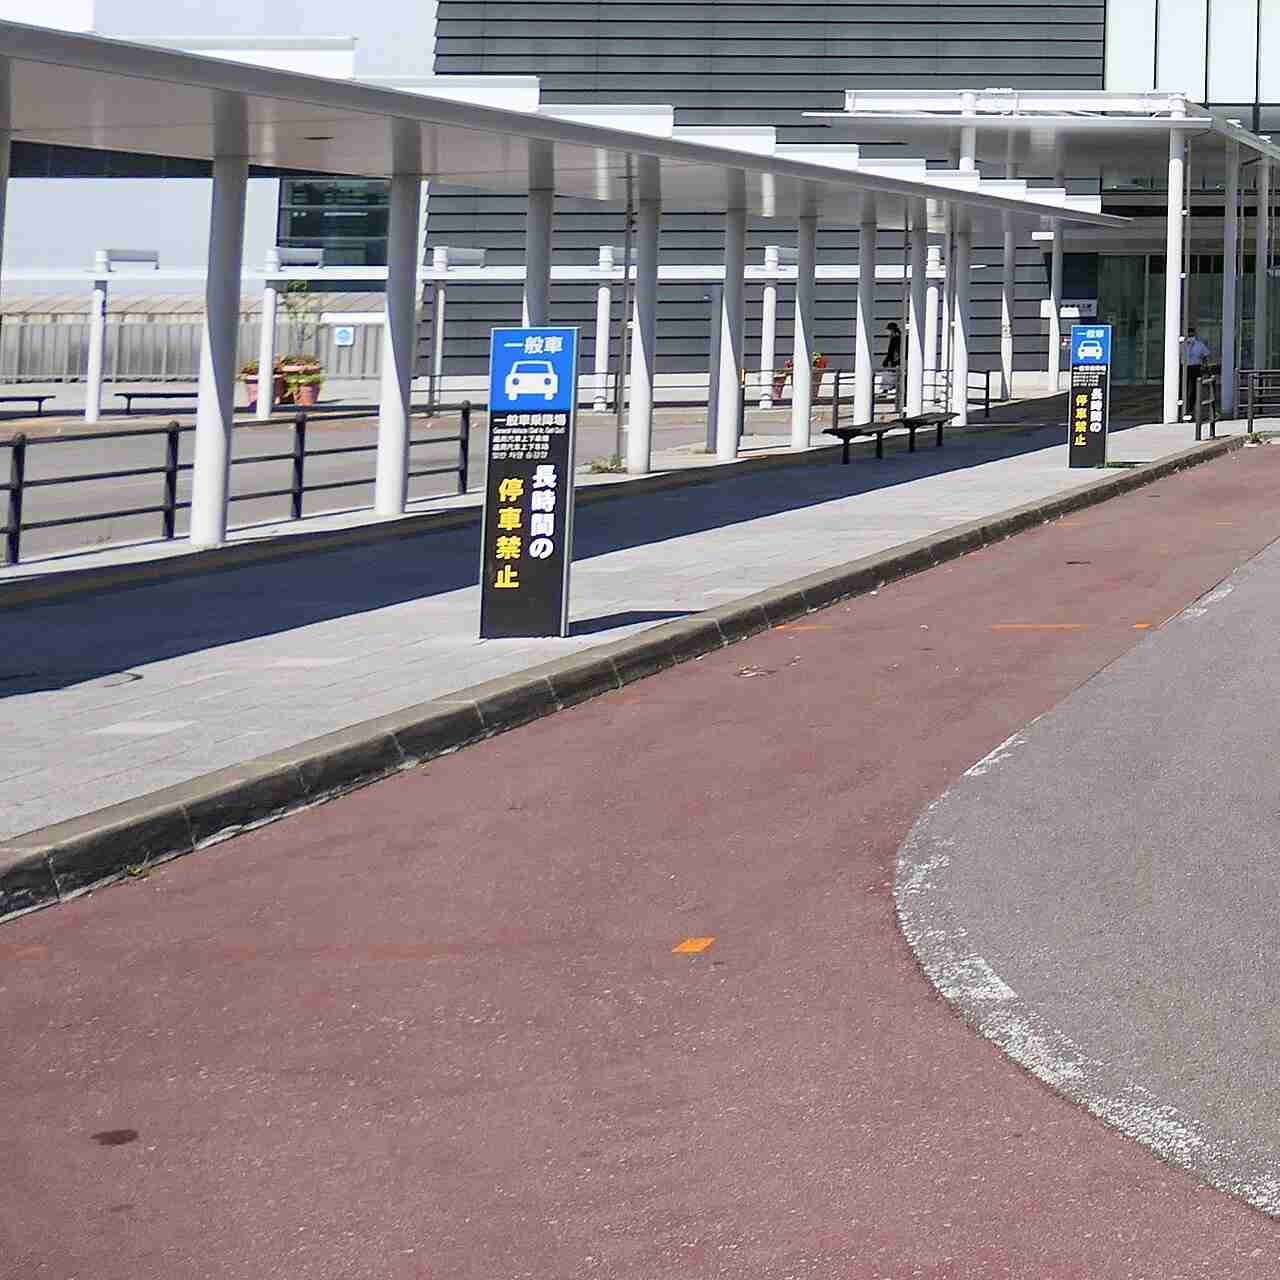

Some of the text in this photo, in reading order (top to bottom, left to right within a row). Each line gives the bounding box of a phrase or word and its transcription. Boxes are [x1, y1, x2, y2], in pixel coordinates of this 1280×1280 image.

[504, 336, 563, 354] 一般車
[494, 479, 524, 588] 停車禁止
[529, 465, 557, 559] 長時間の
